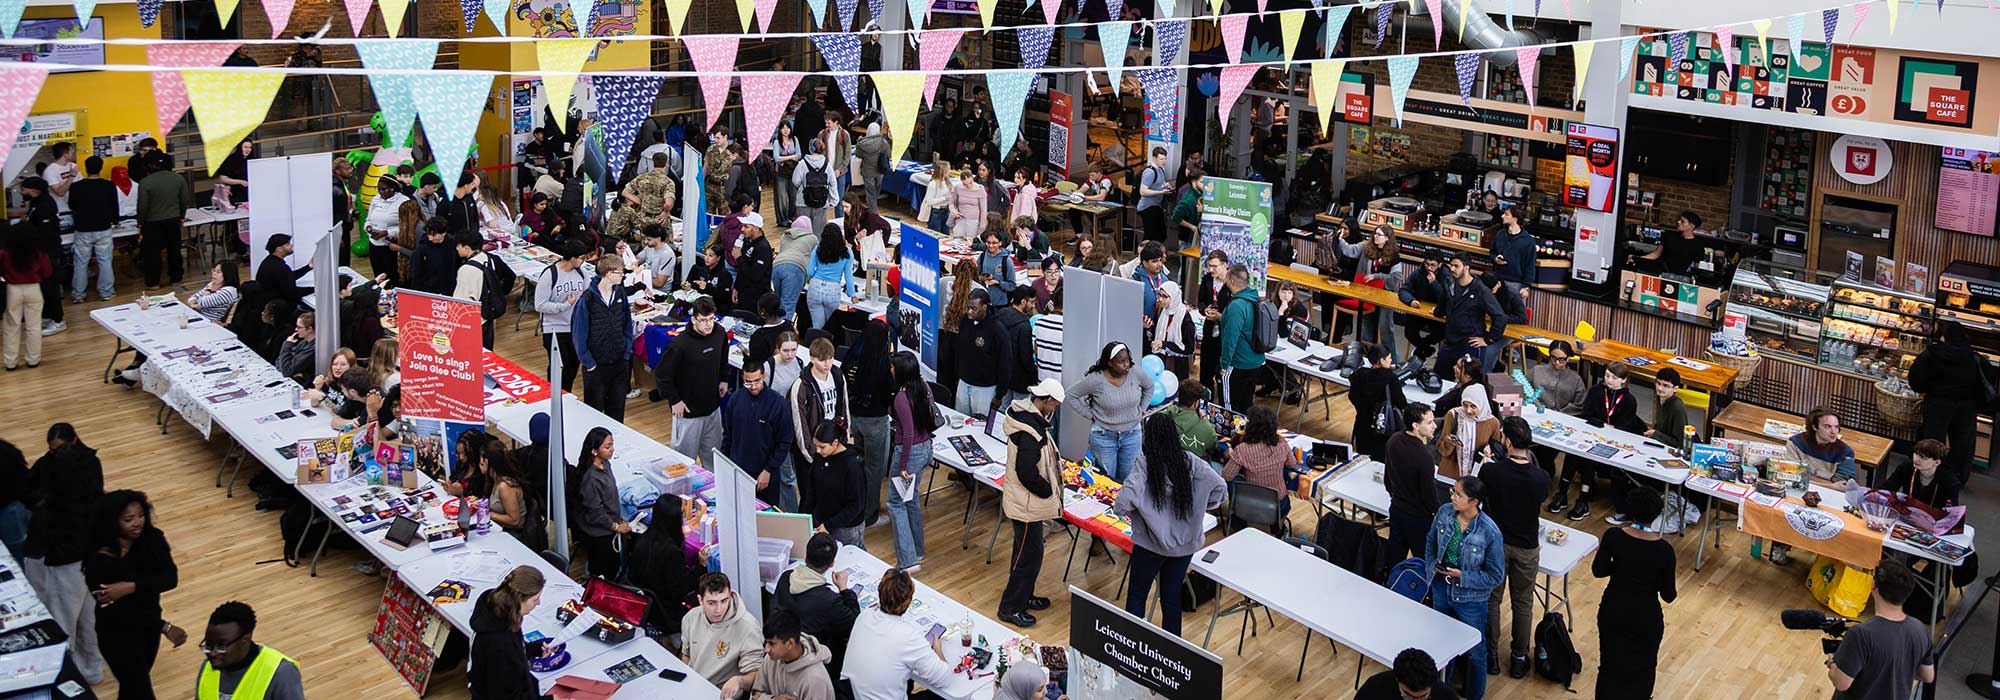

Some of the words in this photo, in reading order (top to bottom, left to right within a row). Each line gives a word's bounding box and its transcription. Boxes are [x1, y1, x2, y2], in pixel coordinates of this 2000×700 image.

[1941, 95, 1956, 103] THE
[1346, 104, 1368, 113] SQUARE
[1929, 101, 1965, 111] SQUARE
[1458, 109, 1475, 117] DRINK
[1481, 113, 1500, 121] GREAT
[1501, 116, 1526, 124] QUALITY
[1228, 191, 1248, 200] Leicester
[1222, 206, 1238, 217] Rugby
[1237, 208, 1252, 217] Union
[432, 310, 448, 319] Club
[413, 351, 433, 362] Love
[434, 355, 444, 364] to
[445, 356, 470, 371] sing?
[409, 361, 428, 371] Join
[429, 365, 449, 376] Glee
[451, 368, 475, 381] Club!
[1095, 619, 1137, 650] Leicester
[1139, 641, 1192, 681] University
[1104, 642, 1149, 674] Chamber
[1151, 666, 1180, 690] Choir
